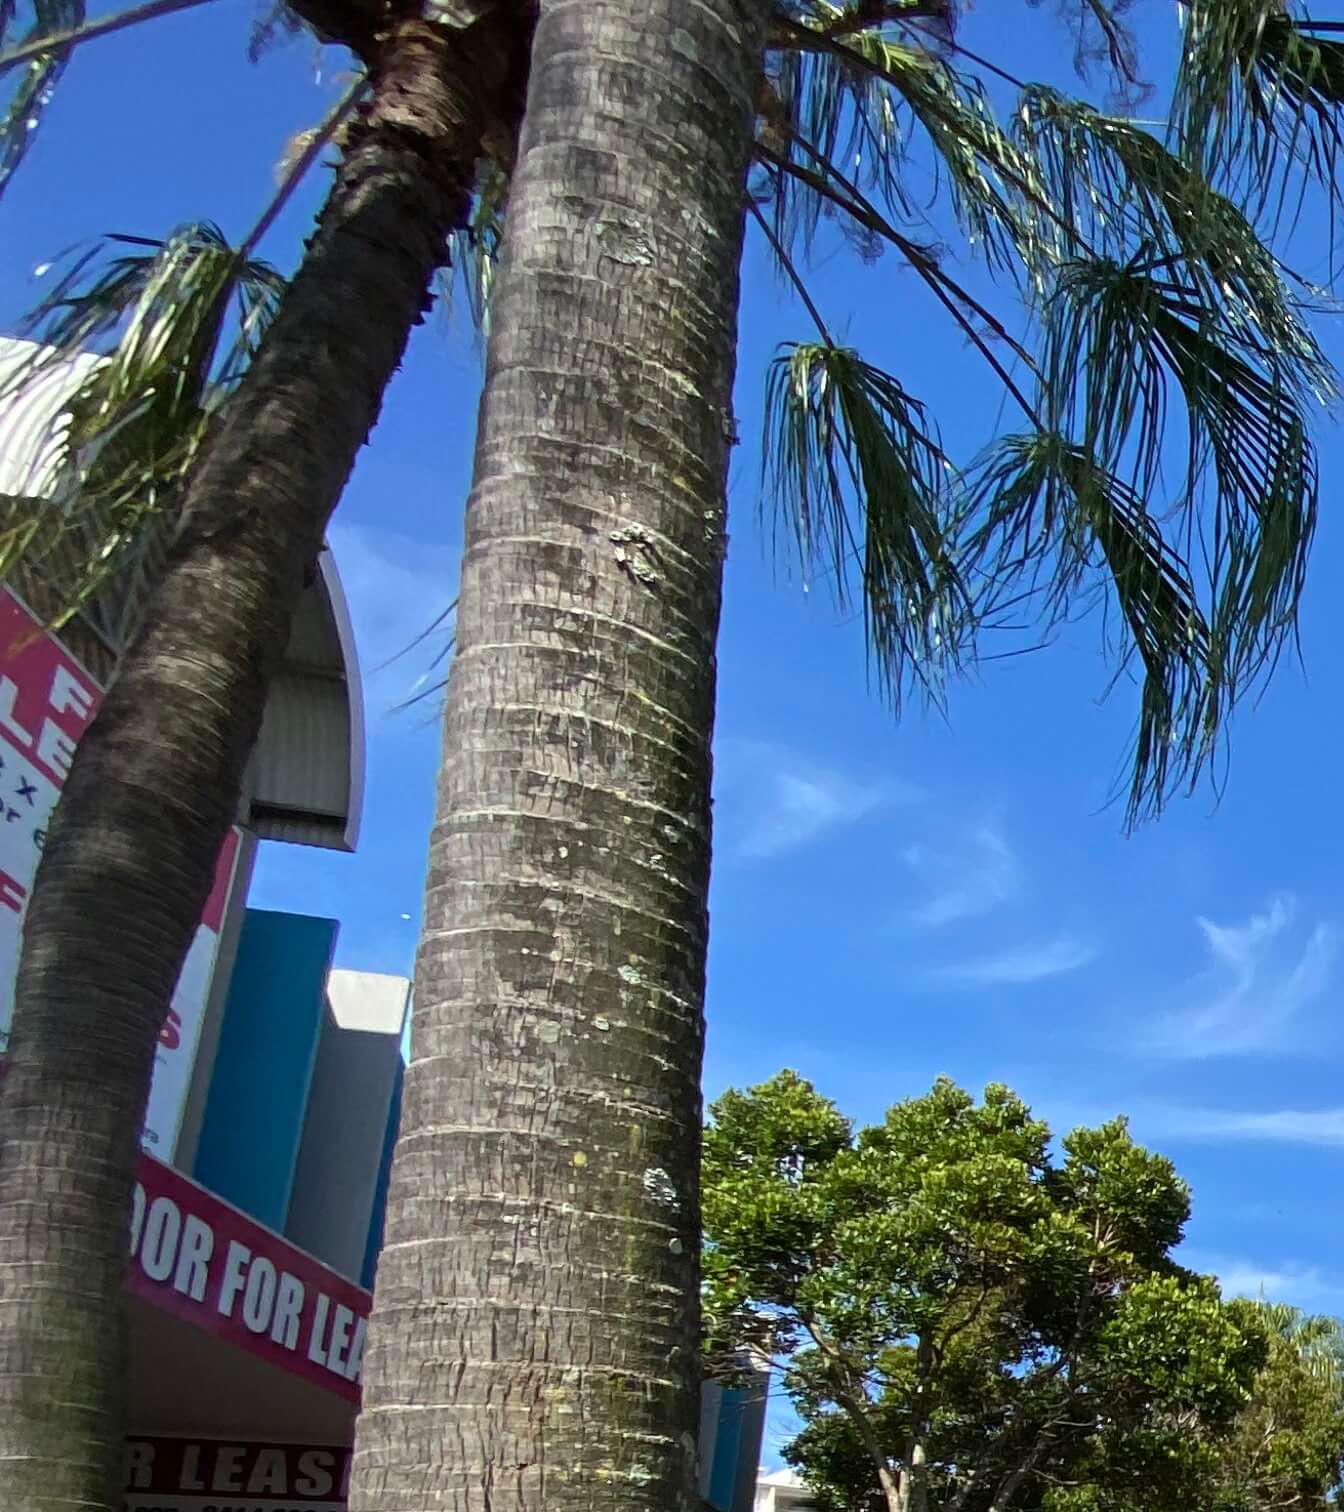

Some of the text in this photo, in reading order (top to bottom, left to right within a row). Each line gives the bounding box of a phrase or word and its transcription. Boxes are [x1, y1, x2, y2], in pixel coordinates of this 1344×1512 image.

[218, 1239, 305, 1350] FOR
[308, 1292, 368, 1382] LEA
[179, 1444, 348, 1496] LEAS
